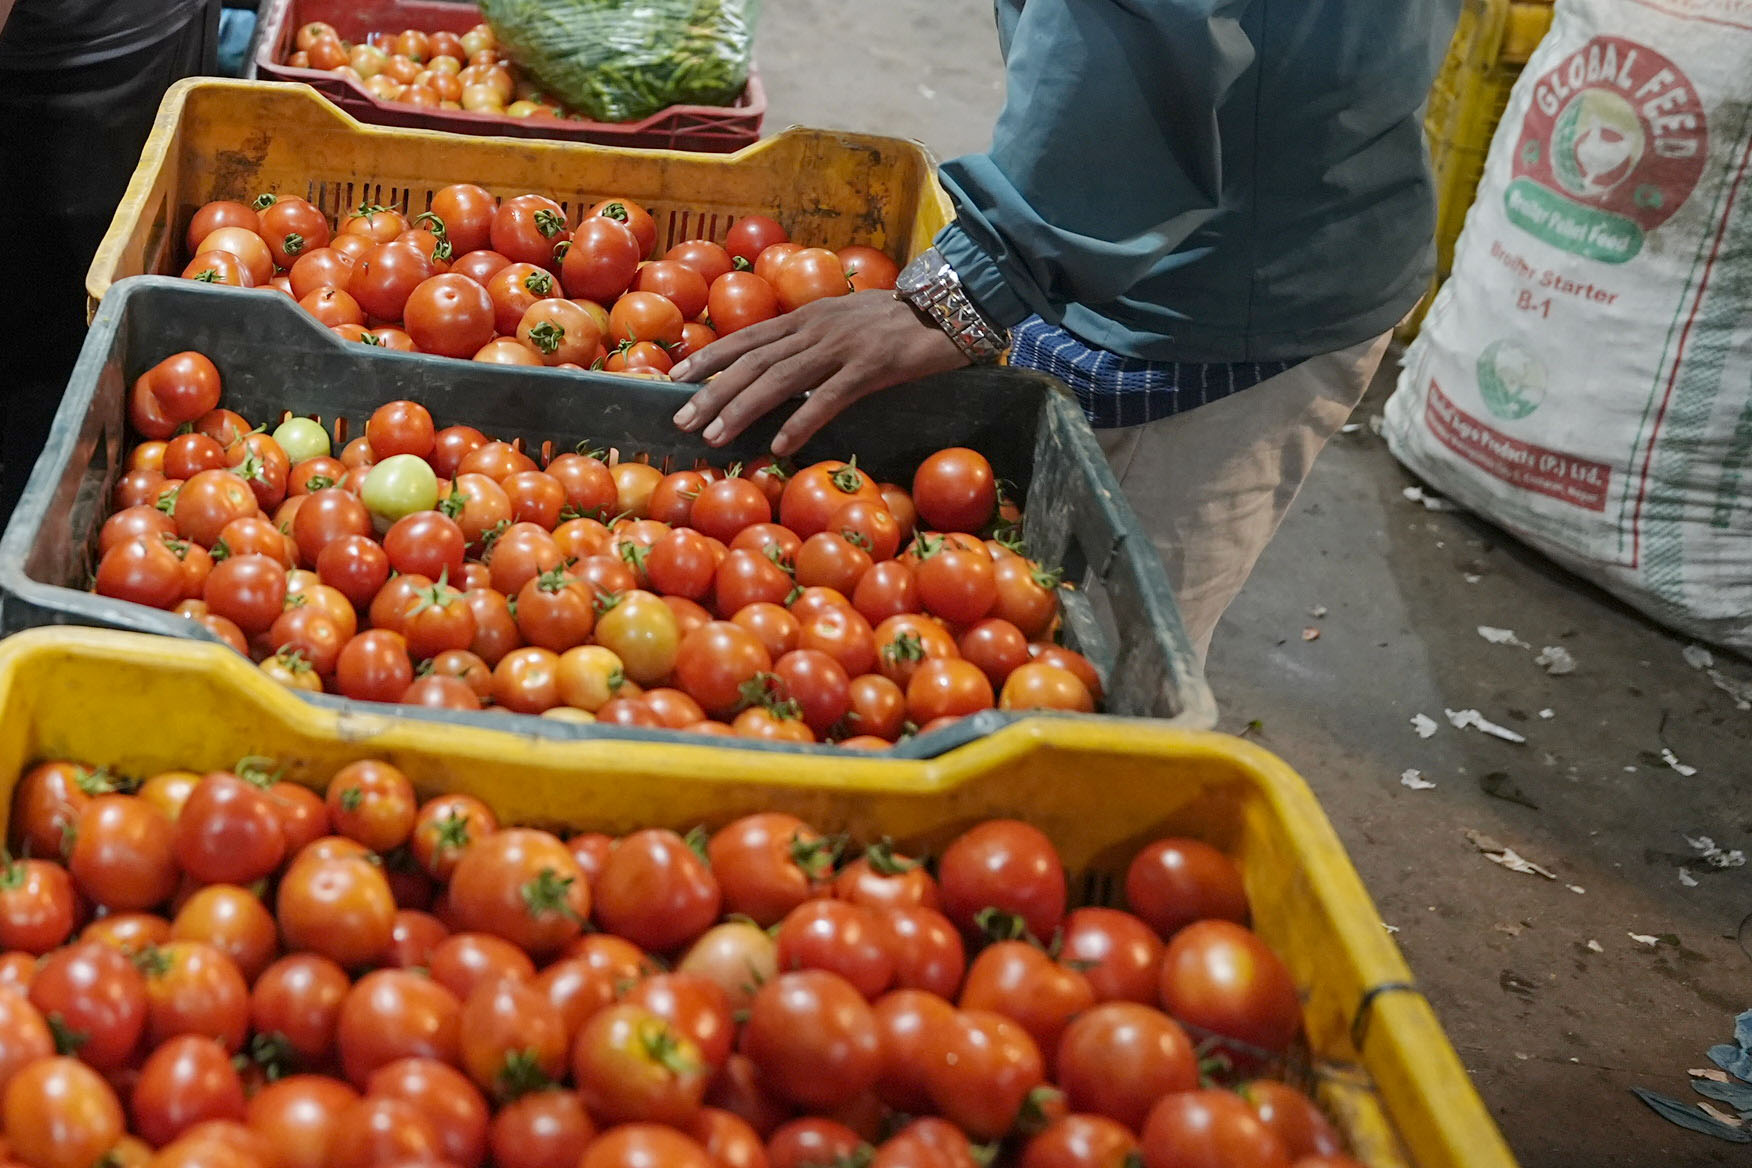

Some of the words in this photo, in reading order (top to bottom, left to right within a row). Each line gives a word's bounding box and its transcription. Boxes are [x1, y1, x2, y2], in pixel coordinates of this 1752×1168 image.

[1536, 43, 1638, 116] GLOBAL
[1635, 68, 1698, 158] FEED
[1539, 270, 1619, 305] Starter
[1539, 454, 1567, 478] (P.)
[1570, 463, 1603, 486] Ltd.
